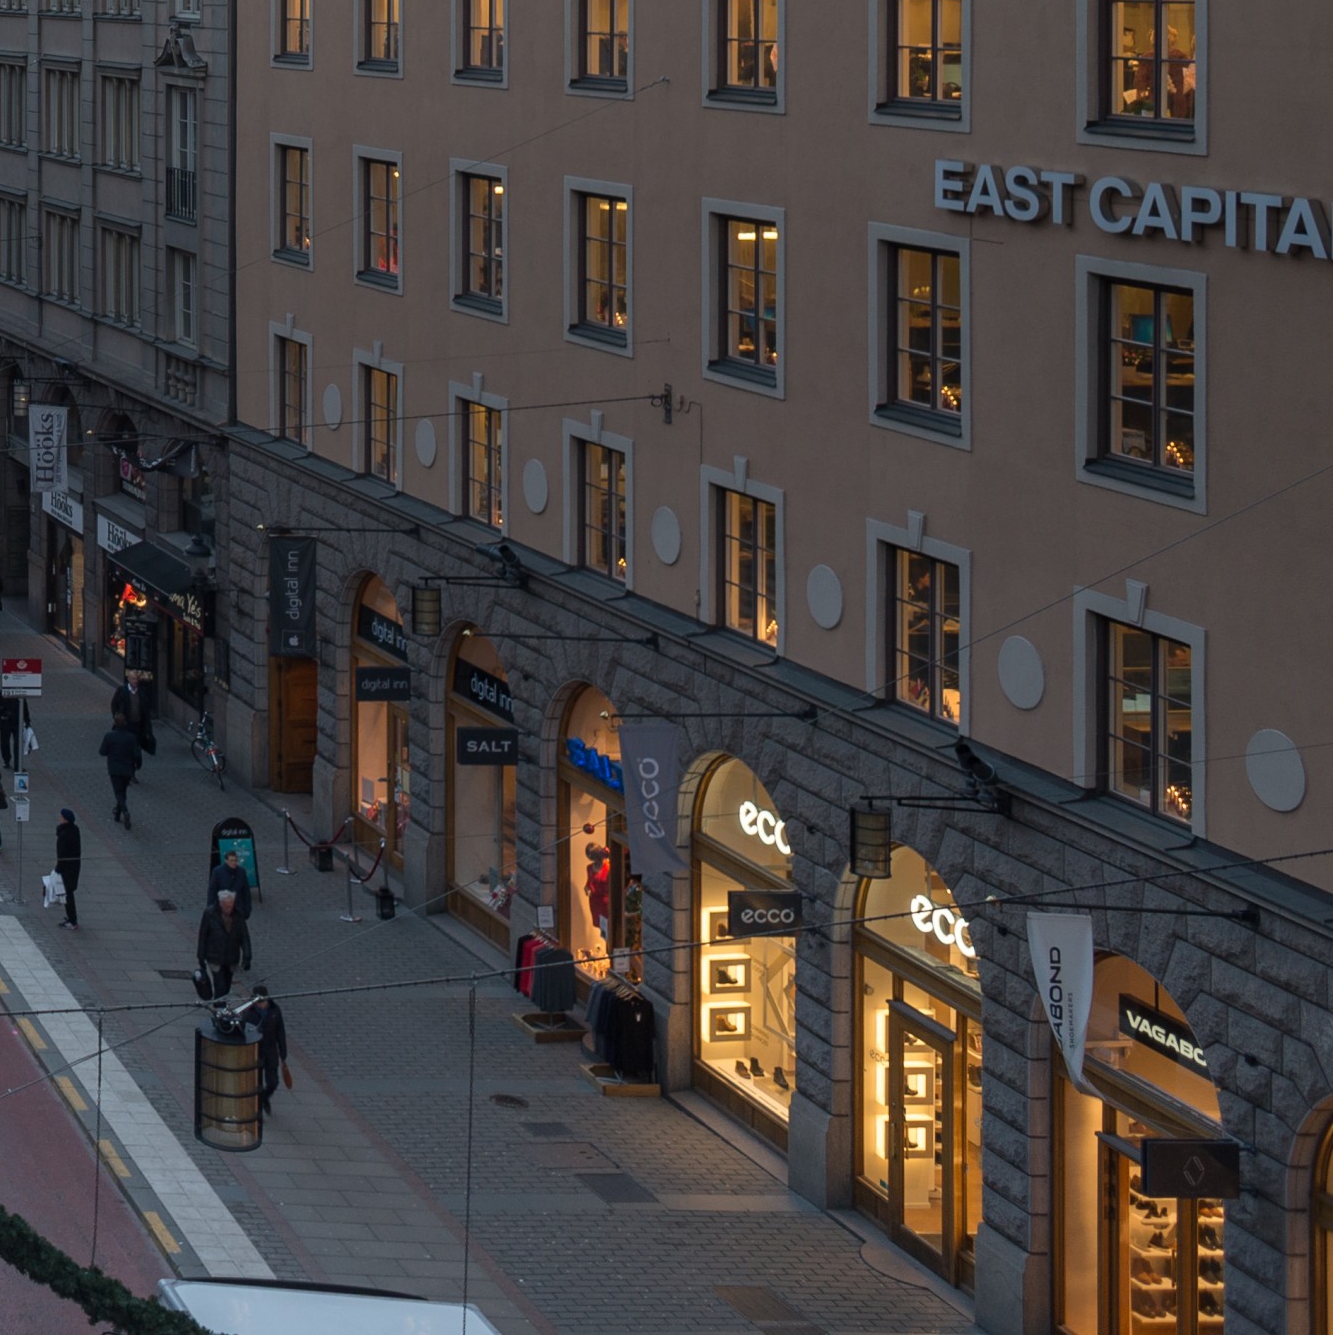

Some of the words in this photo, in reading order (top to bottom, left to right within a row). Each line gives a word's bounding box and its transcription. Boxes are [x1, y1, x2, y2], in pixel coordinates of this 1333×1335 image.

[935, 158, 1077, 225] EAST
[1089, 176, 1333, 262] CAPITA
[35, 413, 54, 484] Hööks
[286, 550, 299, 572] inn
[284, 577, 303, 620] digital
[371, 616, 395, 645] digital
[361, 677, 391, 692] digital
[393, 678, 408, 689] inn
[470, 671, 497, 704] digital
[498, 691, 514, 714] inn
[466, 740, 512, 753] SALT
[636, 757, 666, 839] ecco
[739, 801, 792, 855] ecc
[741, 907, 795, 924] ecco
[910, 894, 976, 957] ecc
[1049, 946, 1063, 1050] ABOND
[1126, 1009, 1208, 1067] VAGABO
